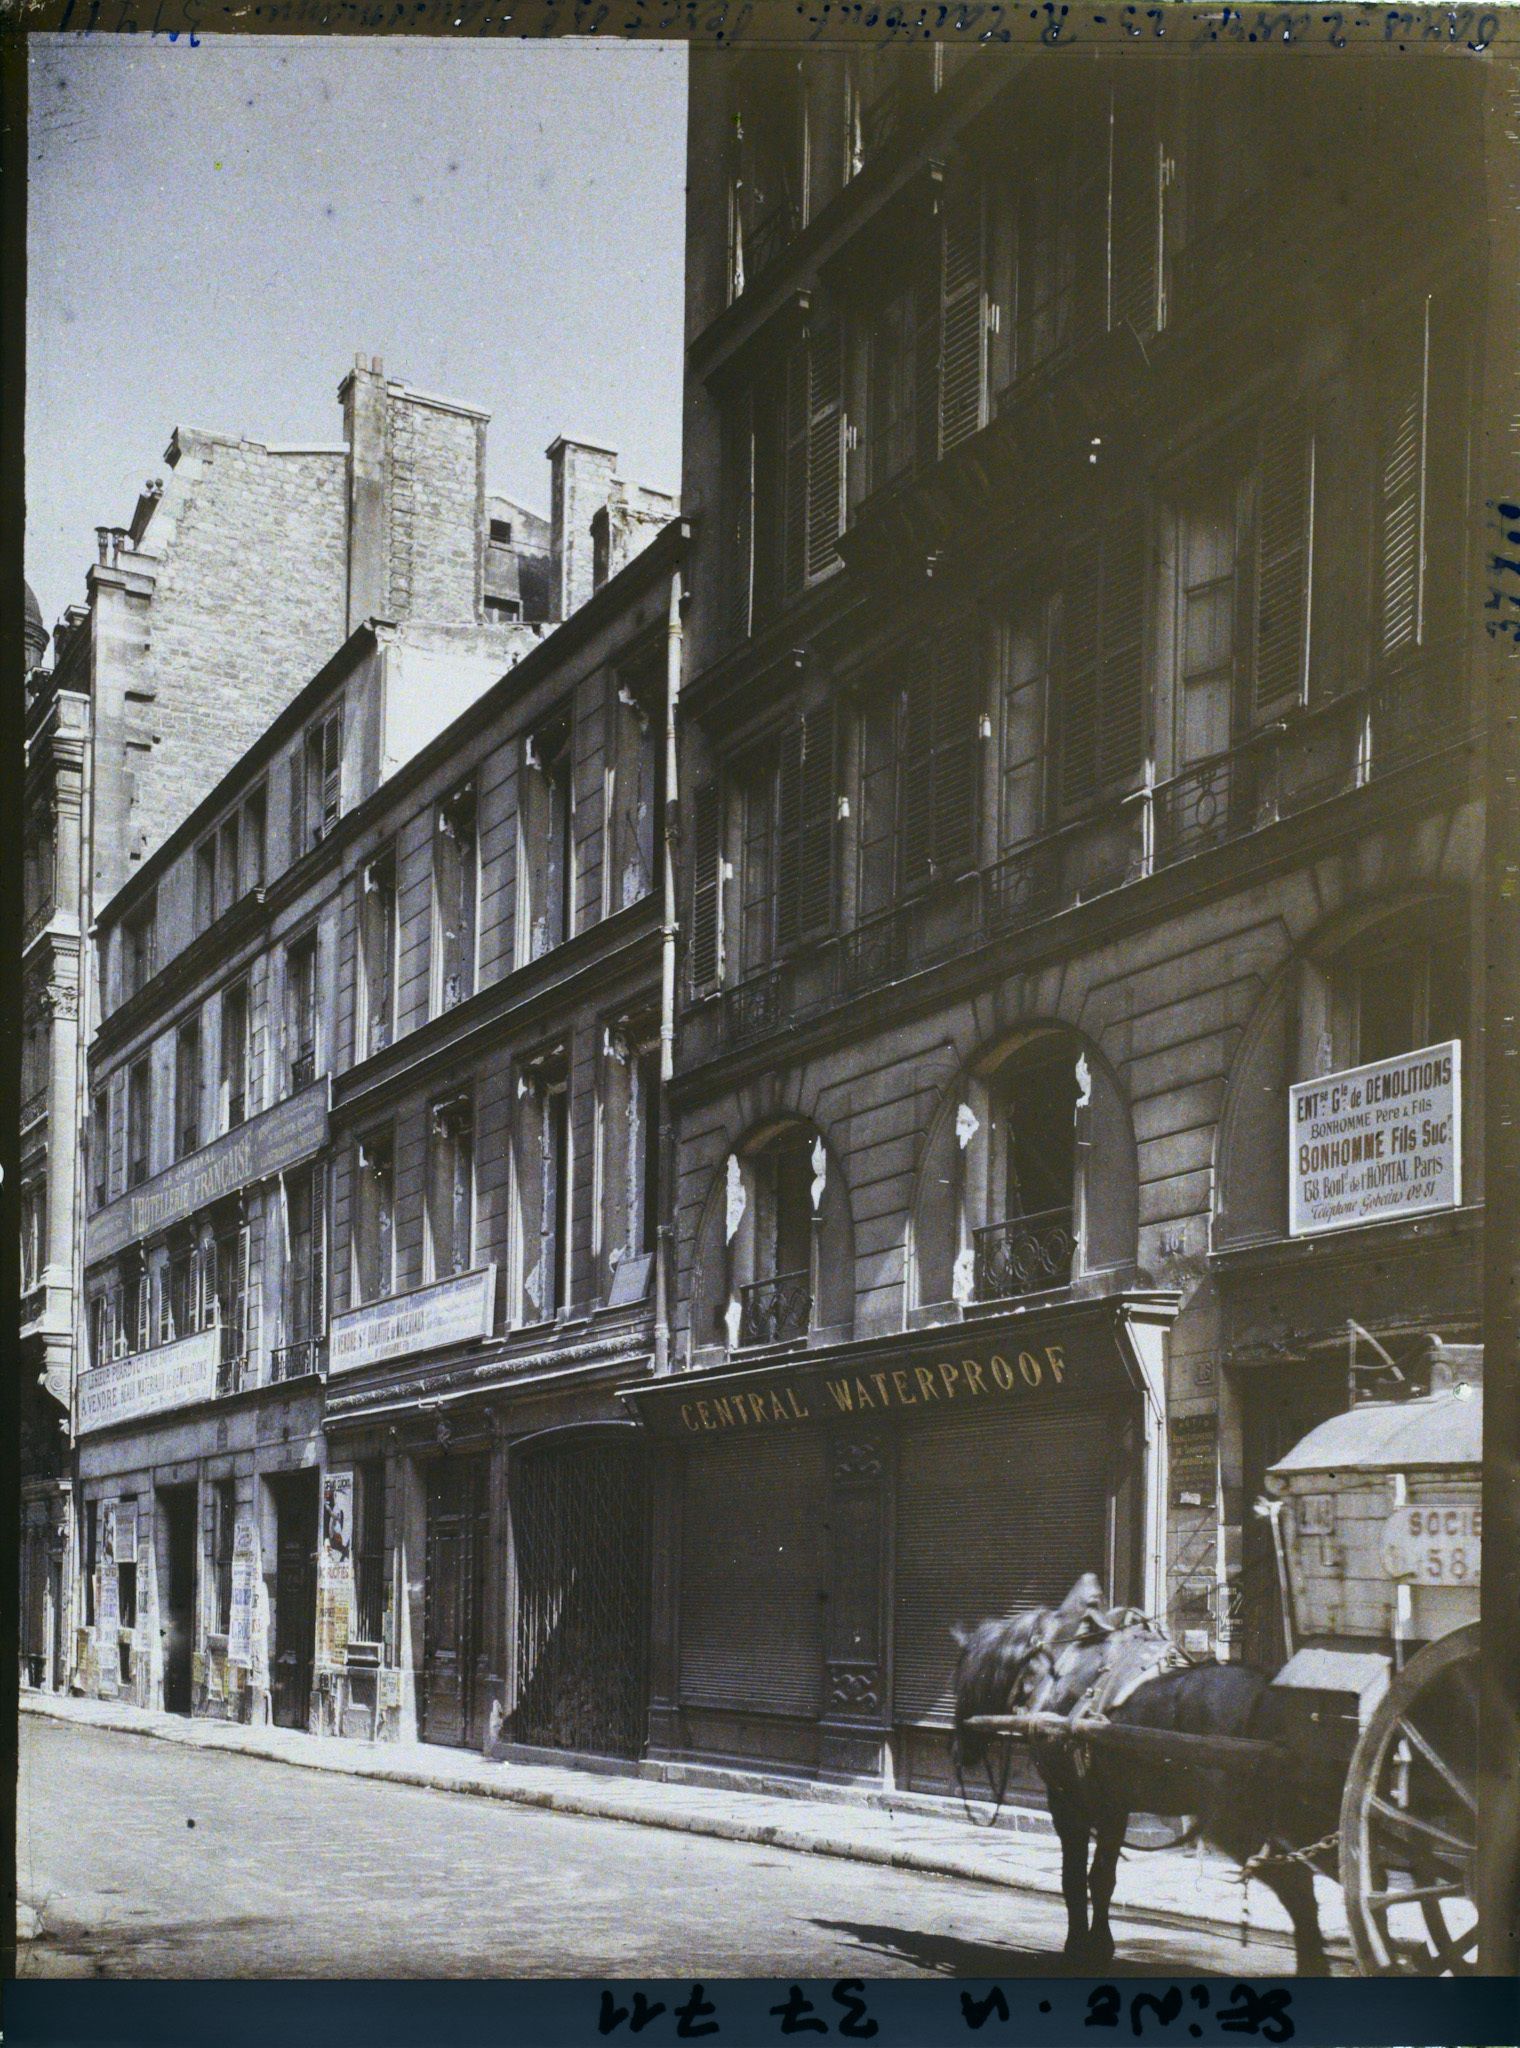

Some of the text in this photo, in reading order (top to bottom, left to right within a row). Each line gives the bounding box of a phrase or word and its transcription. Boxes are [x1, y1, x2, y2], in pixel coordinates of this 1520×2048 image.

[1350, 1087, 1361, 1109] de
[1412, 1098, 1433, 1115] Fils
[1299, 1130, 1384, 1176] BONHOMME
[1391, 1124, 1417, 1155] Fils
[1414, 1155, 1443, 1179] Paris
[681, 1345, 1068, 1432] CENTRAL WATERPROOF
